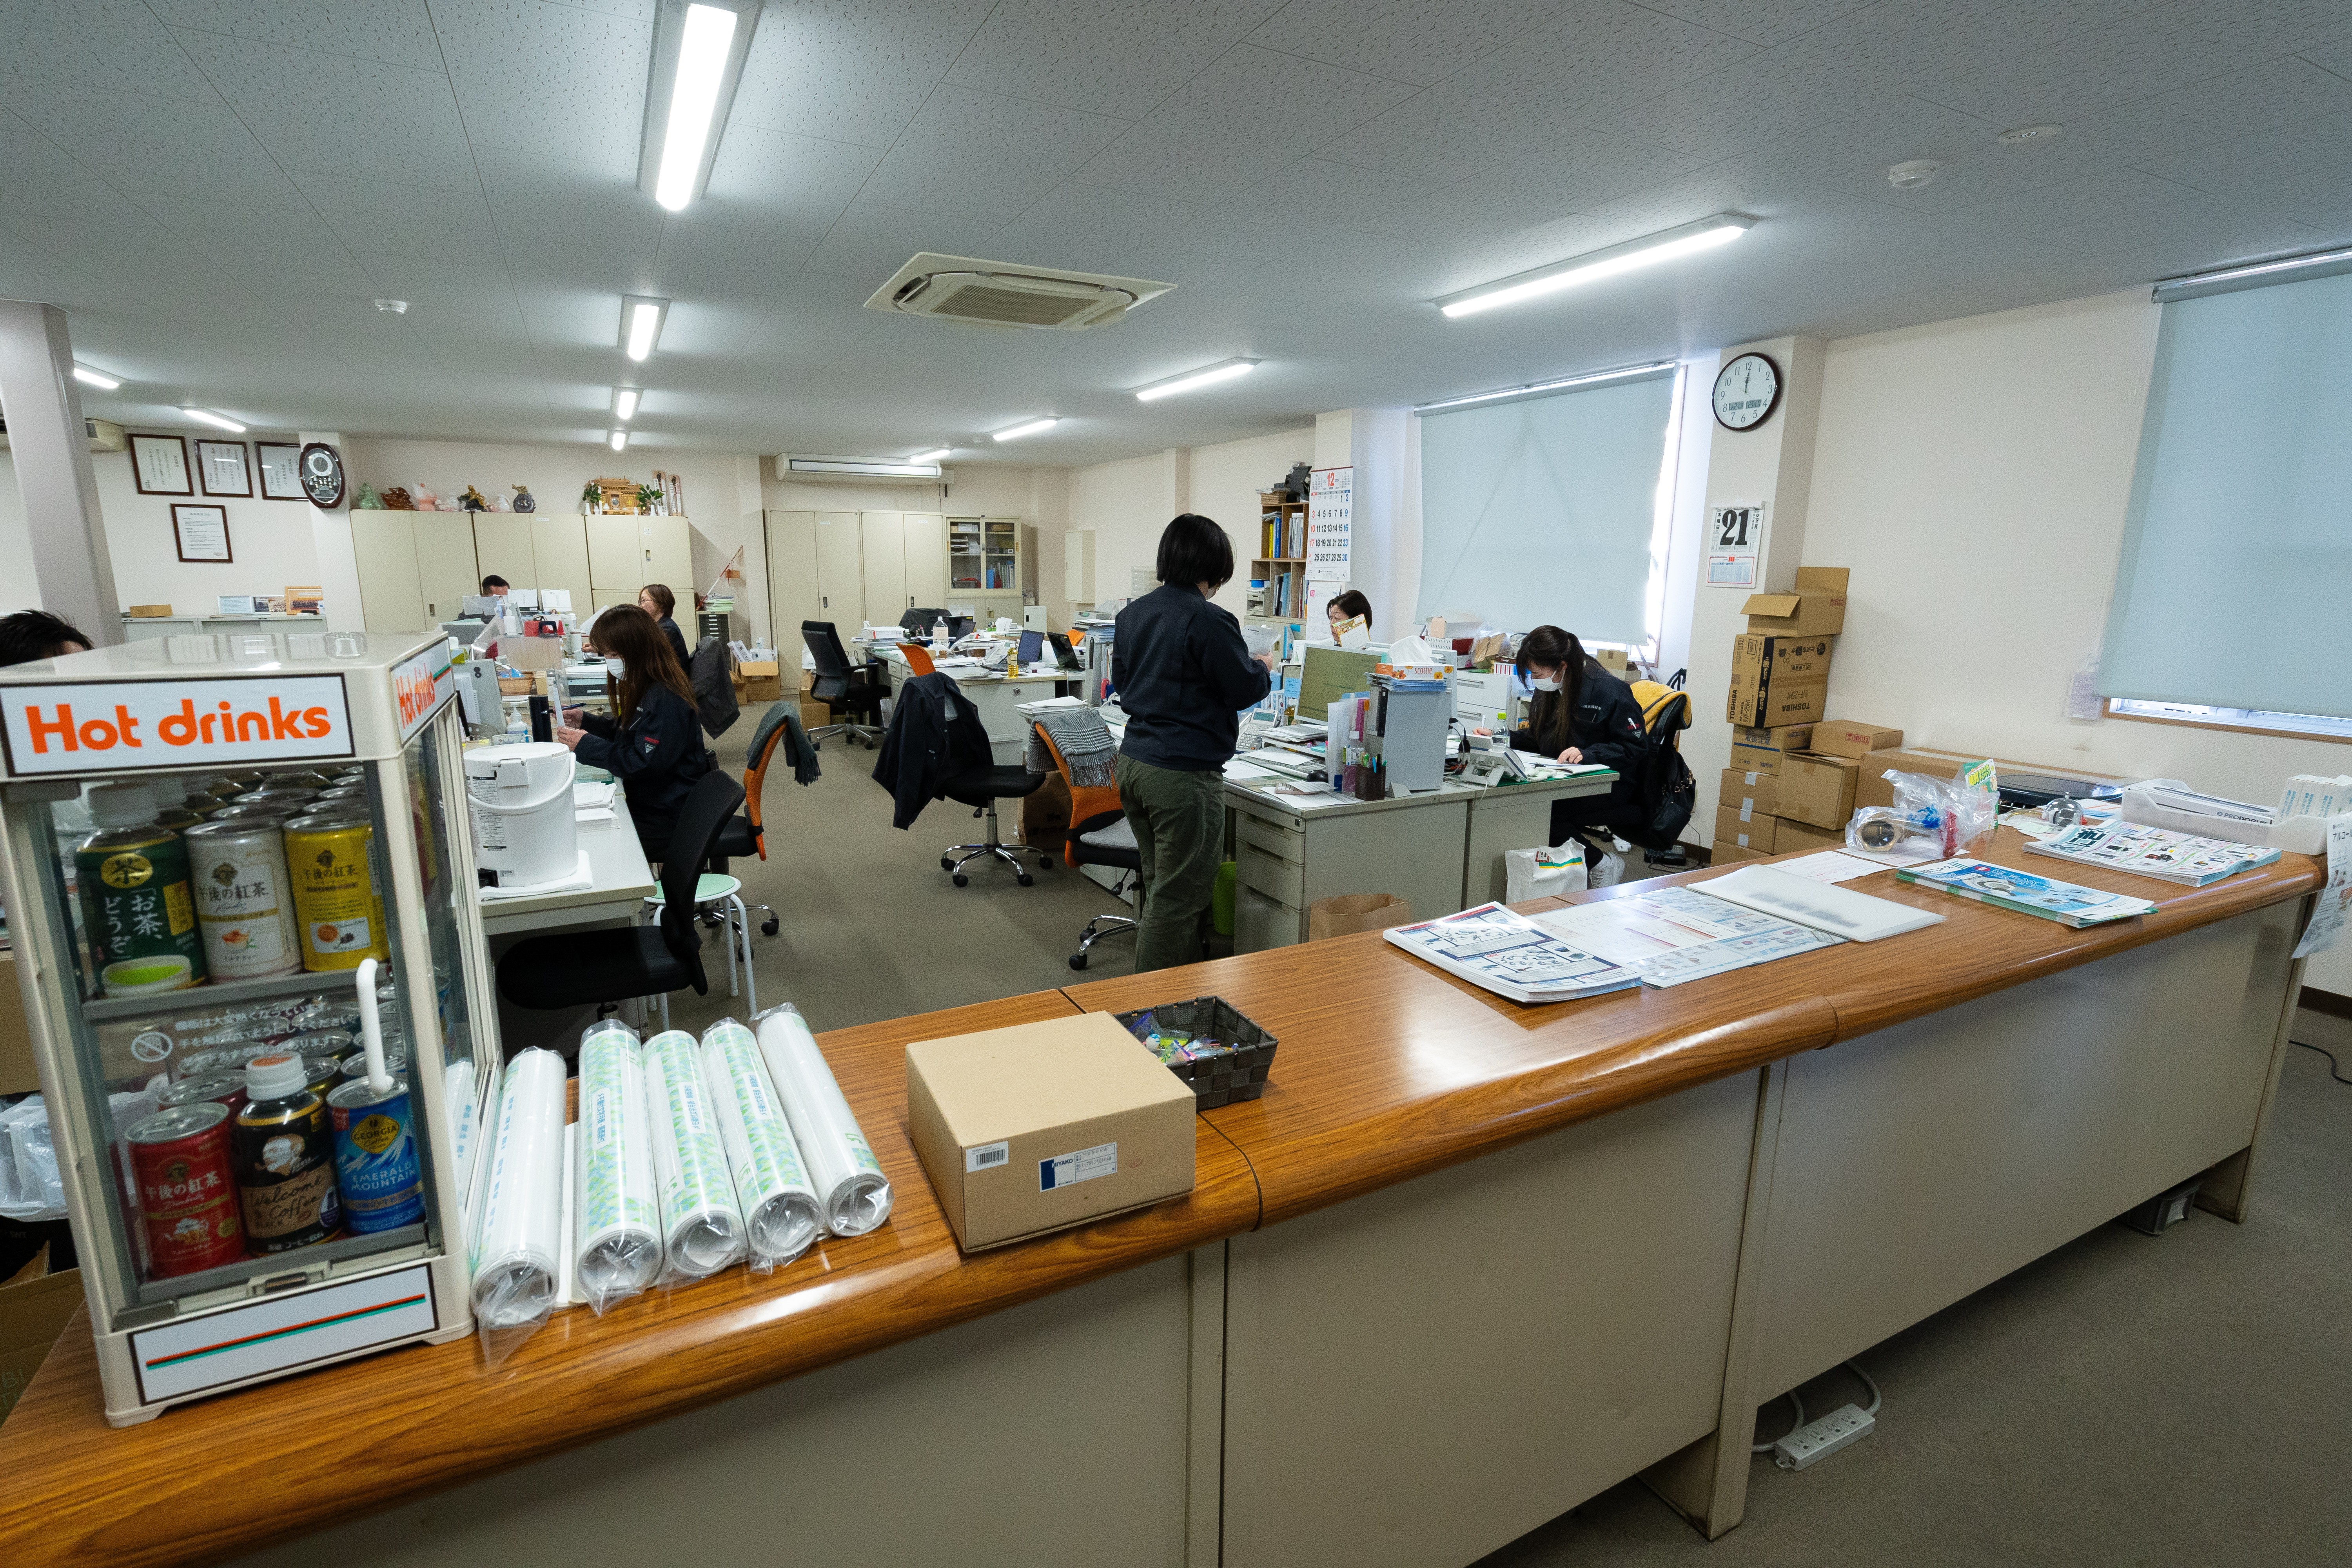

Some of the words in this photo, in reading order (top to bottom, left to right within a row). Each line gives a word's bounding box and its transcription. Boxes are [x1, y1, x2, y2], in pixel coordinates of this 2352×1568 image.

[1746, 361, 1752, 371] 12
[1759, 363, 1761, 372] 1
[1735, 367, 1740, 376] 11
[1765, 371, 1770, 381] 2
[1725, 377, 1731, 387] 10
[1768, 385, 1772, 394] 3
[1720, 391, 1725, 400] 9
[1722, 403, 1727, 412] 8
[1762, 399, 1768, 407] 4
[1731, 412, 1735, 421] 7
[1741, 414, 1746, 423] 6
[1753, 409, 1757, 419] 5
[1327, 472, 1334, 486] 12
[1720, 509, 1749, 546] 21
[396, 679, 416, 729] Hot
[414, 663, 436, 713] drinks
[1782, 702, 1810, 712] TOSHIBA
[25, 703, 142, 754] Hot
[158, 696, 331, 747] drinks
[1745, 735, 1770, 745] 取扱注意
[109, 858, 146, 885] 茶
[354, 1124, 397, 1141] GEORGIA
[1052, 1158, 1073, 1168] MIYAKO
[352, 1161, 412, 1183] EMERALD
[351, 1167, 416, 1191] MOUNTAIN
[145, 1170, 222, 1201] 午後の紅茶
[250, 1175, 324, 1207] Welcome
[269, 1196, 320, 1220] Coffee
